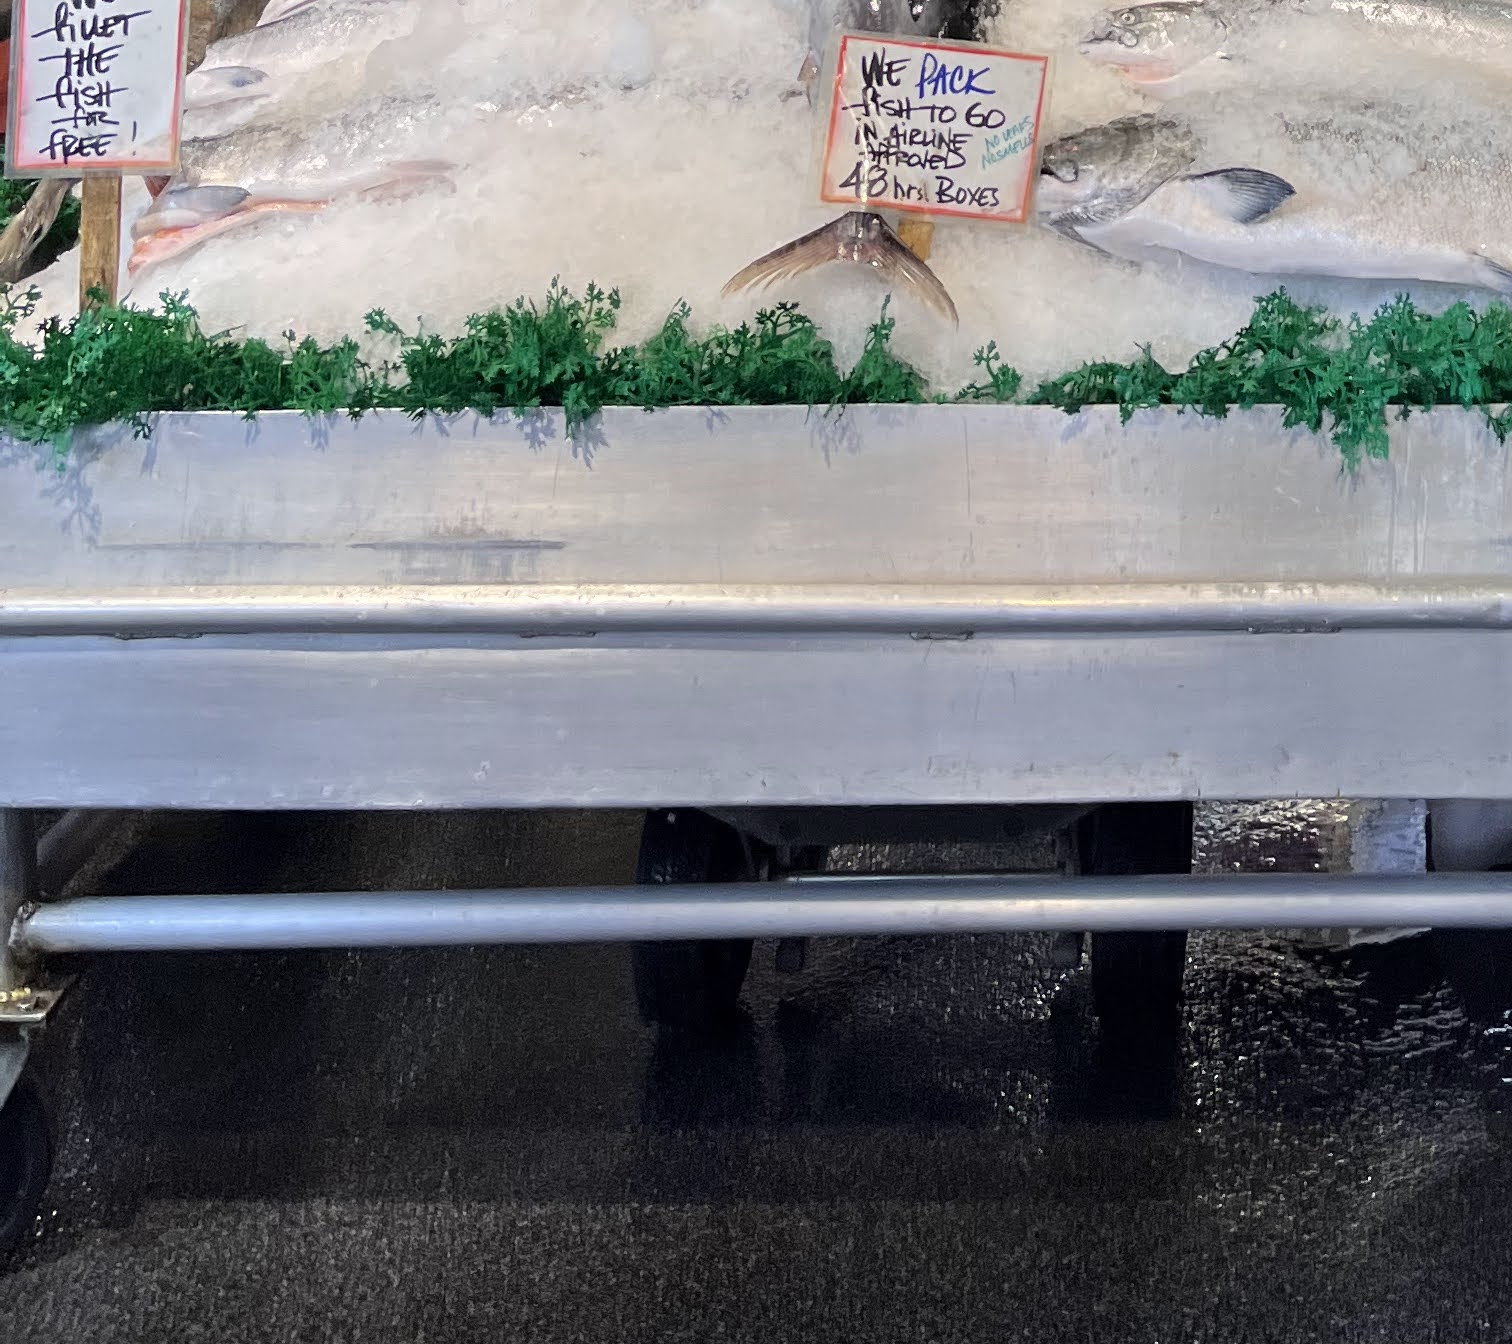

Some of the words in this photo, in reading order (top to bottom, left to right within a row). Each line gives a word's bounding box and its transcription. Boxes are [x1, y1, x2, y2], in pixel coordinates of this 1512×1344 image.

[37, 40, 126, 79] THE
[861, 46, 912, 88] WE
[914, 51, 997, 100] PACK
[914, 104, 958, 125] TO
[964, 101, 1007, 130] GO
[884, 120, 975, 153] AIRLINE
[934, 175, 1001, 208] BOXES
